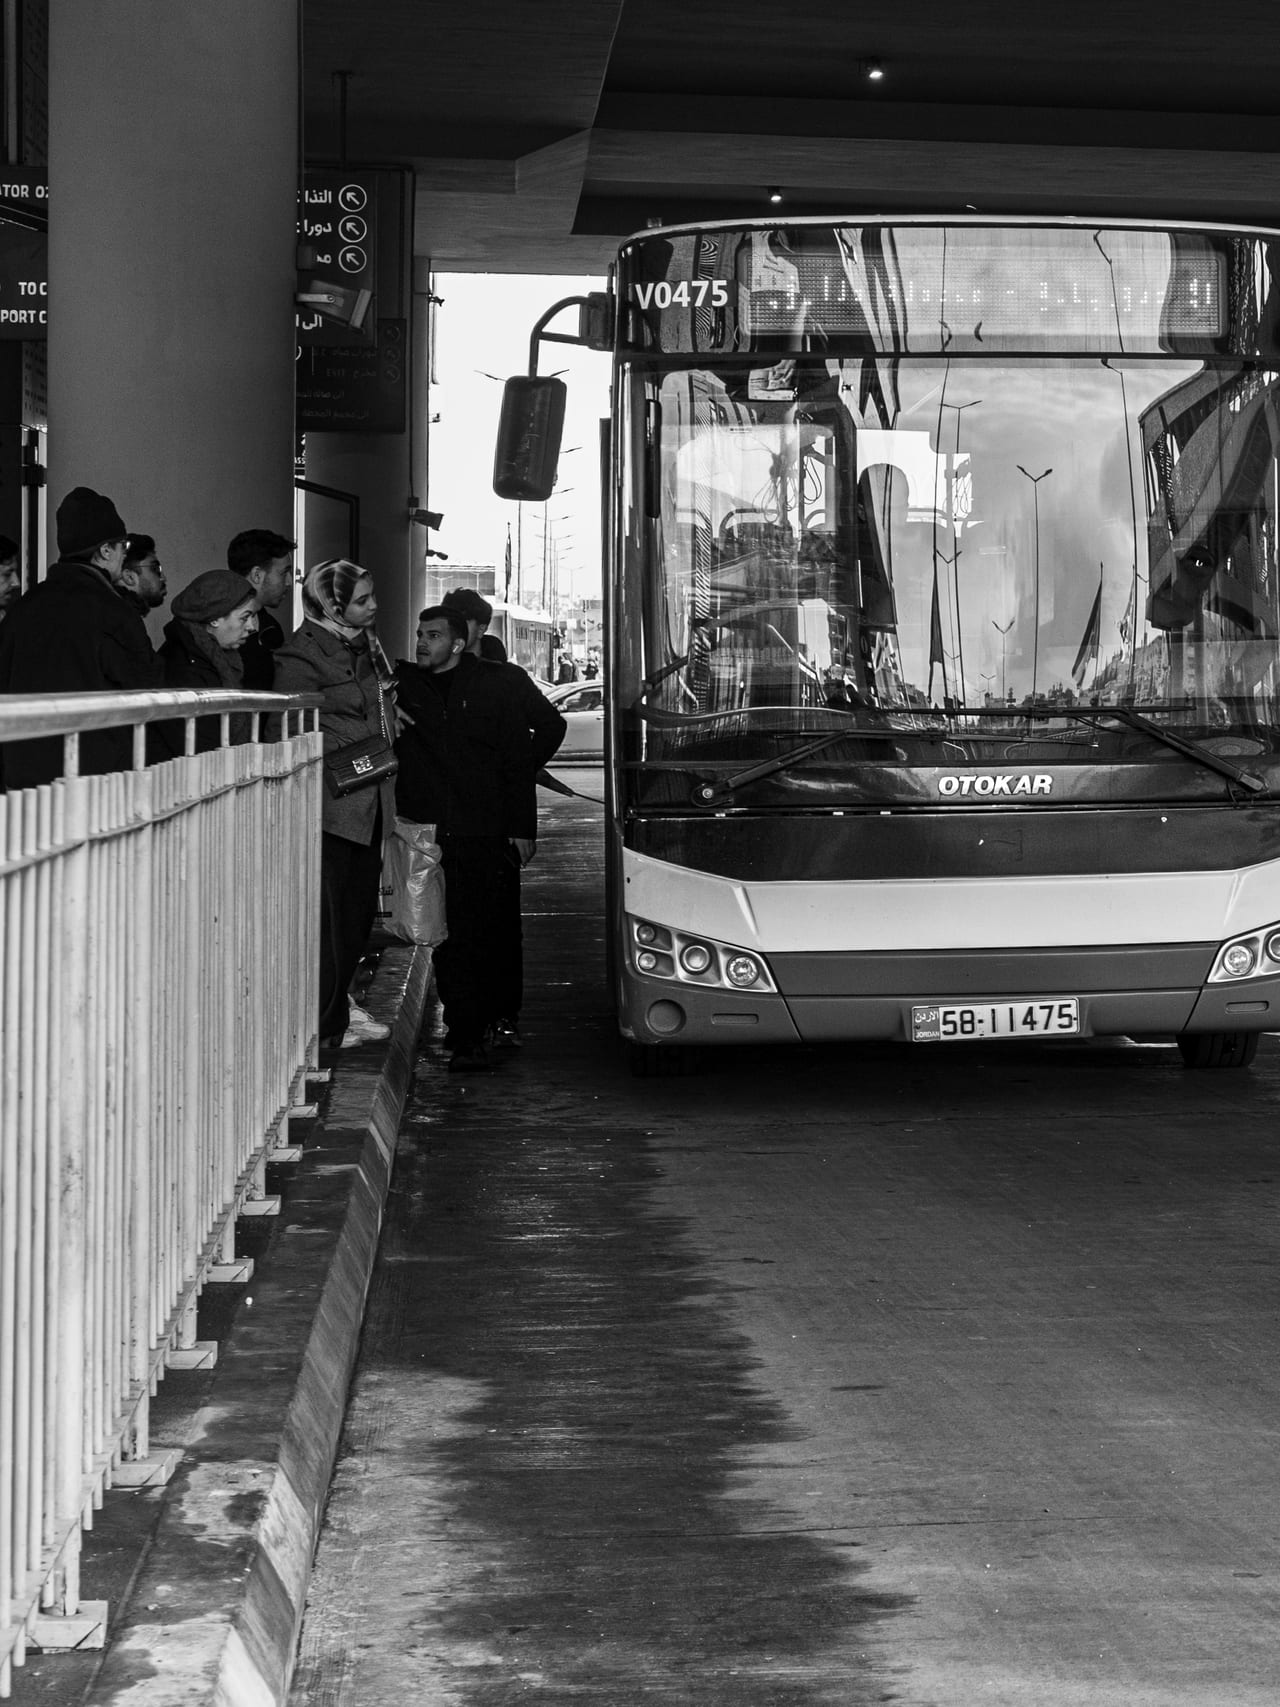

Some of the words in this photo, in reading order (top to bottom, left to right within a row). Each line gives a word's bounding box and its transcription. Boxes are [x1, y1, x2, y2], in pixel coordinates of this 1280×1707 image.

[0, 184, 29, 198] TOR
[18, 281, 37, 296] TO
[634, 279, 728, 310] V0475
[937, 774, 1053, 797] OTOKAR
[916, 1030, 939, 1039] JORDAN
